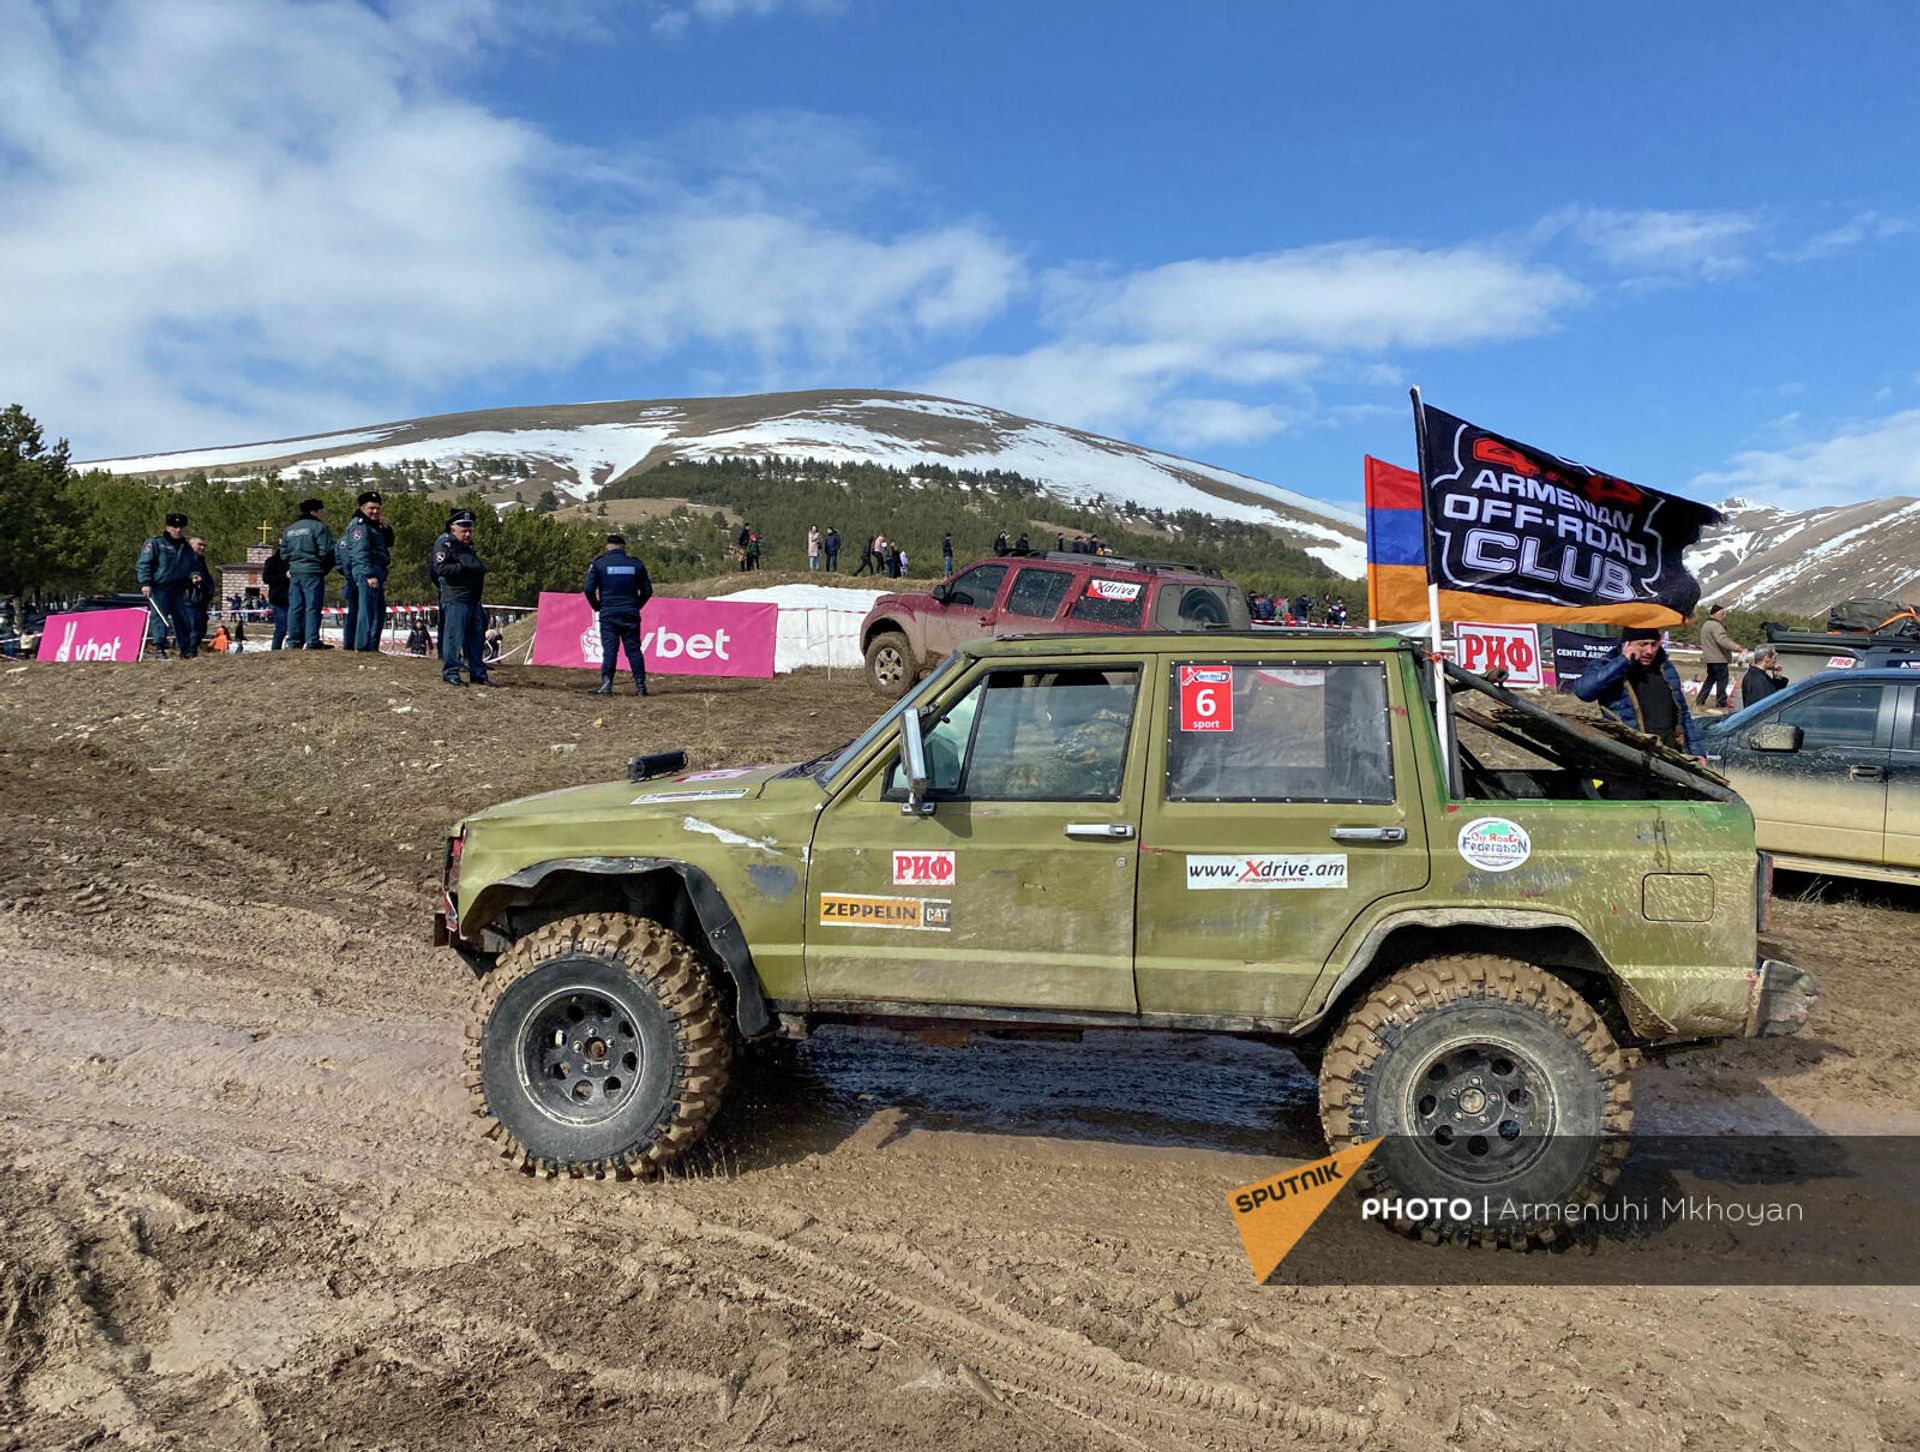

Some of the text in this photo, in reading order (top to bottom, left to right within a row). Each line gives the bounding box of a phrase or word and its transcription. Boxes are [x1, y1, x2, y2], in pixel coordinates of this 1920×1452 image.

[1471, 469, 1634, 533] ARMENIAN
[1443, 493, 1648, 567] OFF-ROAD
[1461, 527, 1637, 600] CLUB
[1096, 581, 1136, 596] Xdrive
[1463, 634, 1533, 672] РИФ
[1557, 648, 1586, 658] CENTER
[1830, 657, 1852, 666] РИФ
[1196, 688, 1216, 716] 6
[1193, 720, 1220, 729] sport
[895, 856, 952, 880] РИФ
[1189, 860, 1345, 882] www.Xdrive.am
[823, 902, 948, 923] ZEPPELIN CAT
